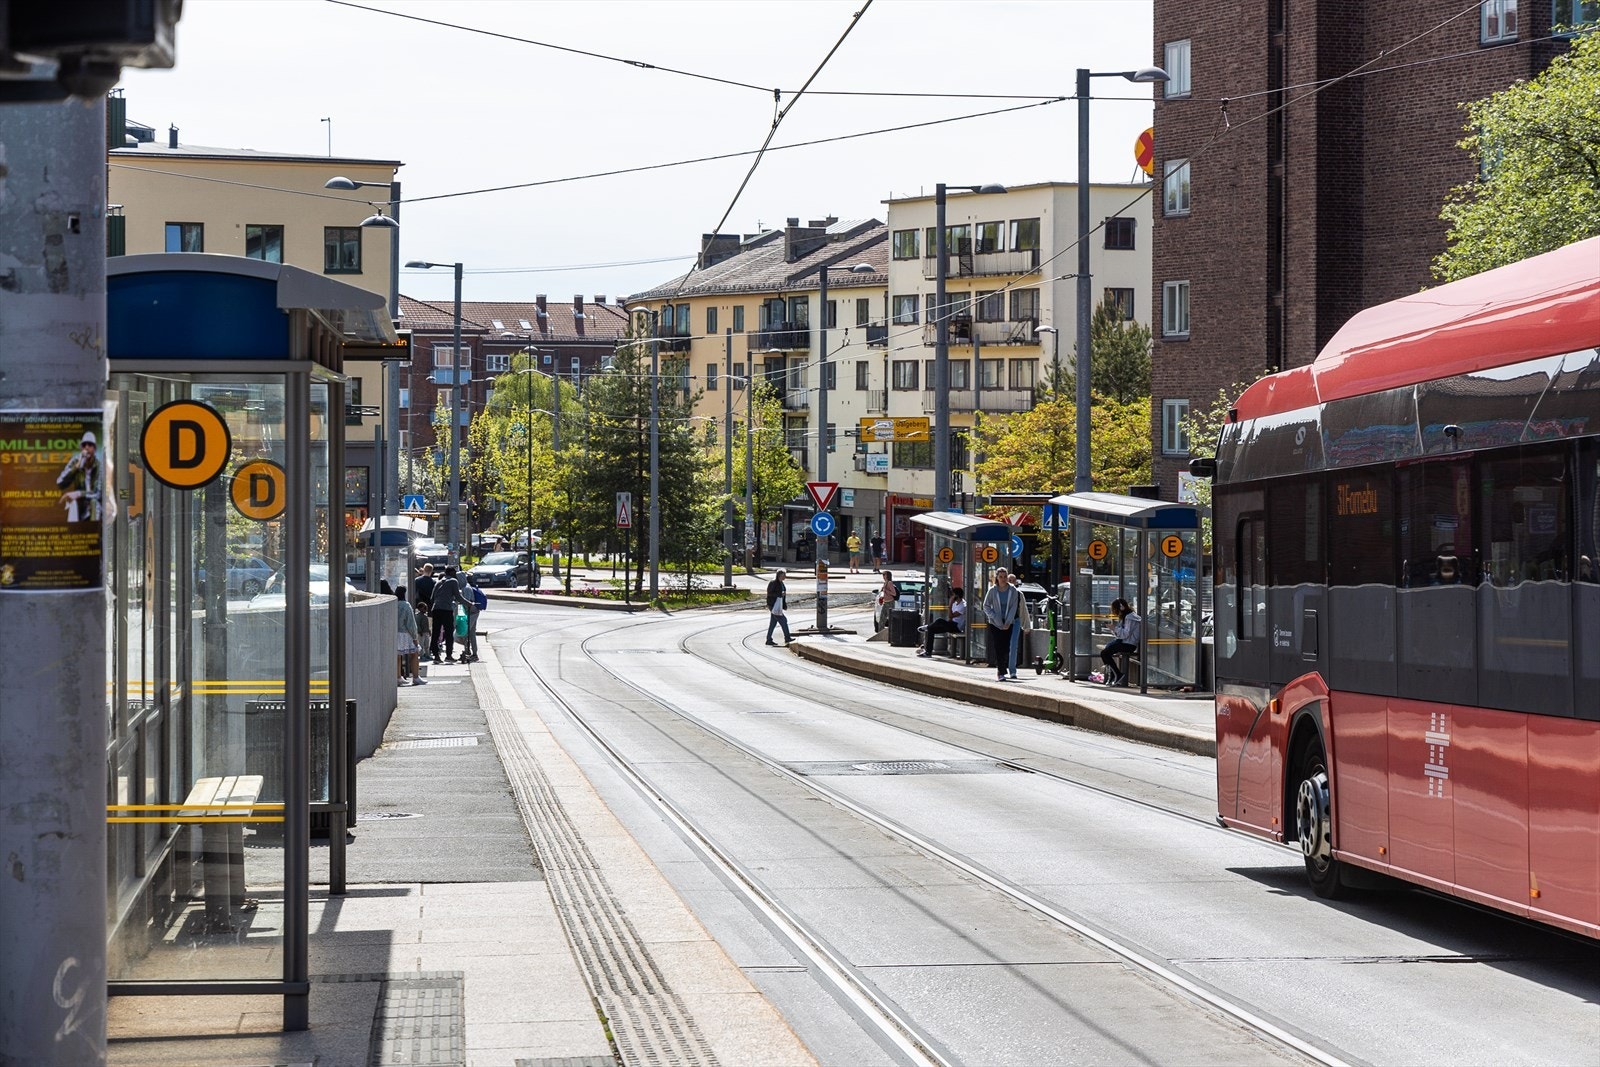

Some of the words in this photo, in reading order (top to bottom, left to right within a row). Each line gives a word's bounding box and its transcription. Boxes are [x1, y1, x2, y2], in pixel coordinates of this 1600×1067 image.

[0, 439, 80, 451] MILLION
[169, 420, 206, 469] D
[250, 473, 276, 508] D
[1093, 544, 1102, 556] E
[1168, 540, 1177, 553] E
[943, 551, 950, 560] E
[986, 550, 994, 560] E
